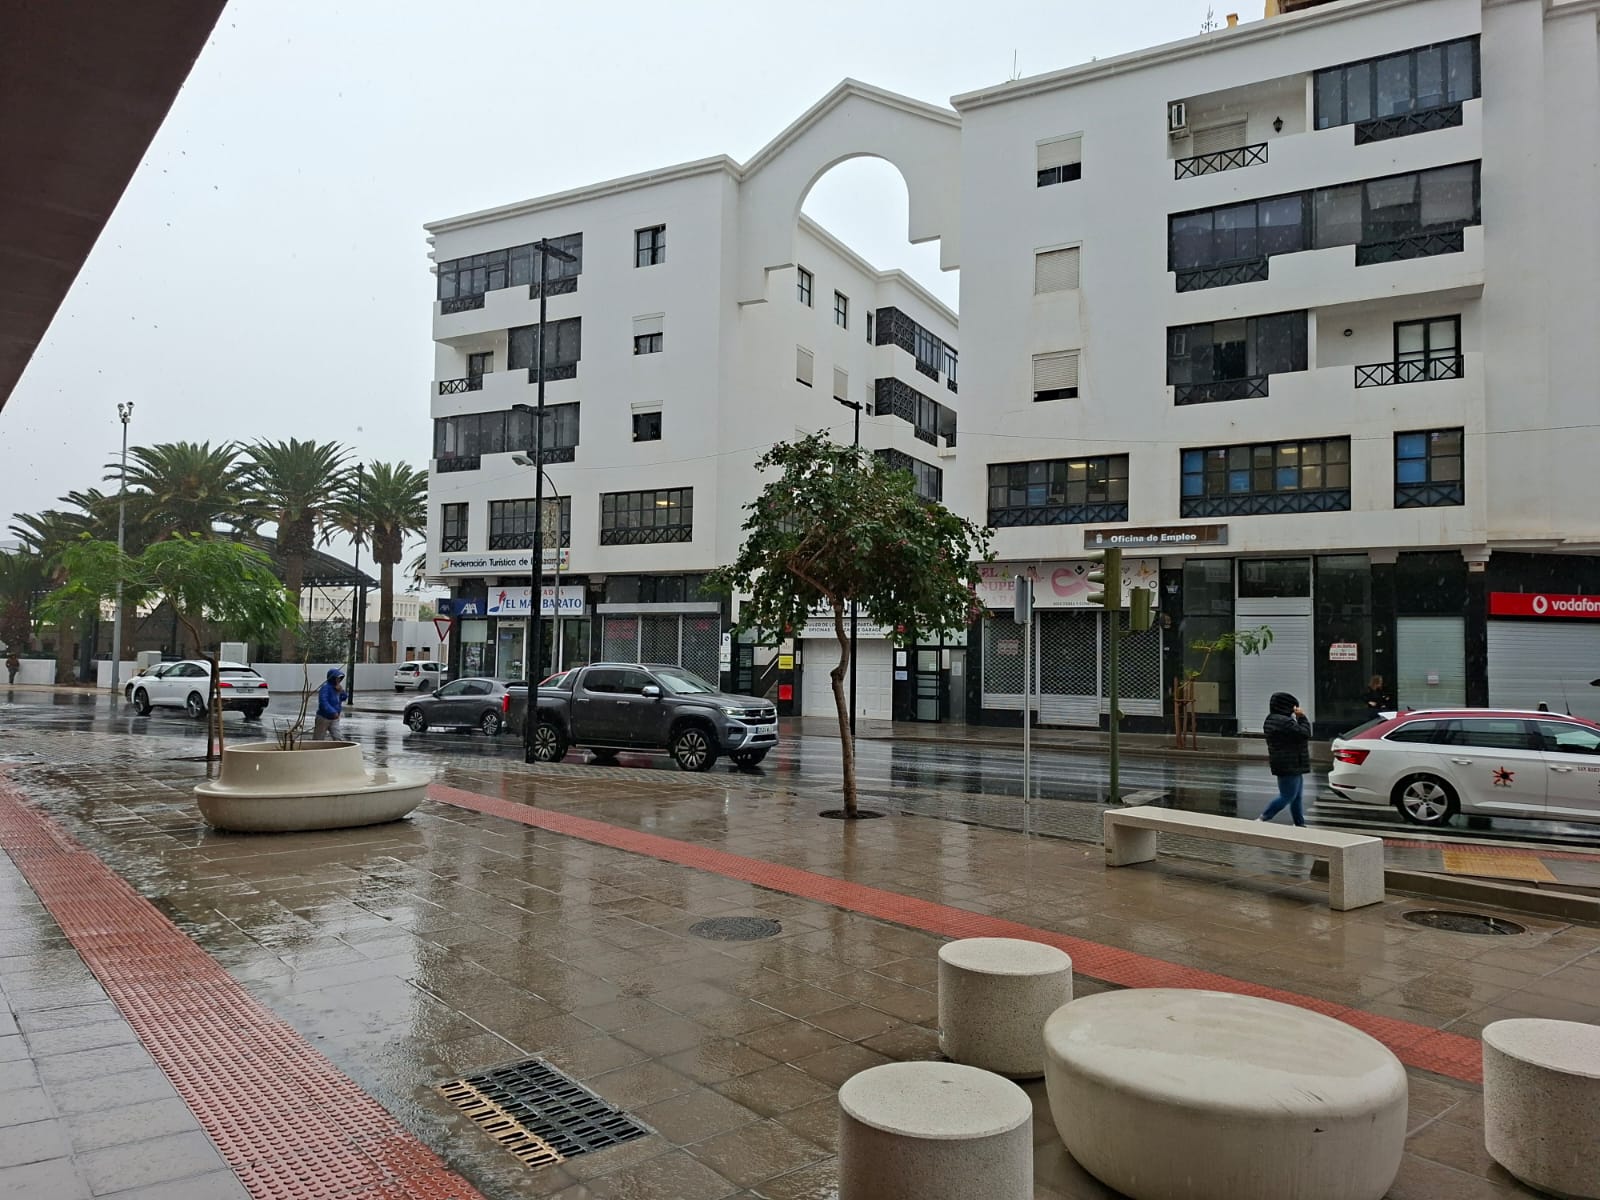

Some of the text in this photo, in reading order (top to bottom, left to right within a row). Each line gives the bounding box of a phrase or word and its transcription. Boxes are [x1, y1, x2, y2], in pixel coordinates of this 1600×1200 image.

[1110, 532, 1197, 544] Oficina de Empleo
[449, 559, 487, 569] Federación
[489, 558, 516, 567] Turística
[518, 558, 528, 566] de
[460, 602, 479, 615] AXA
[505, 598, 582, 609] EL MA BARATO
